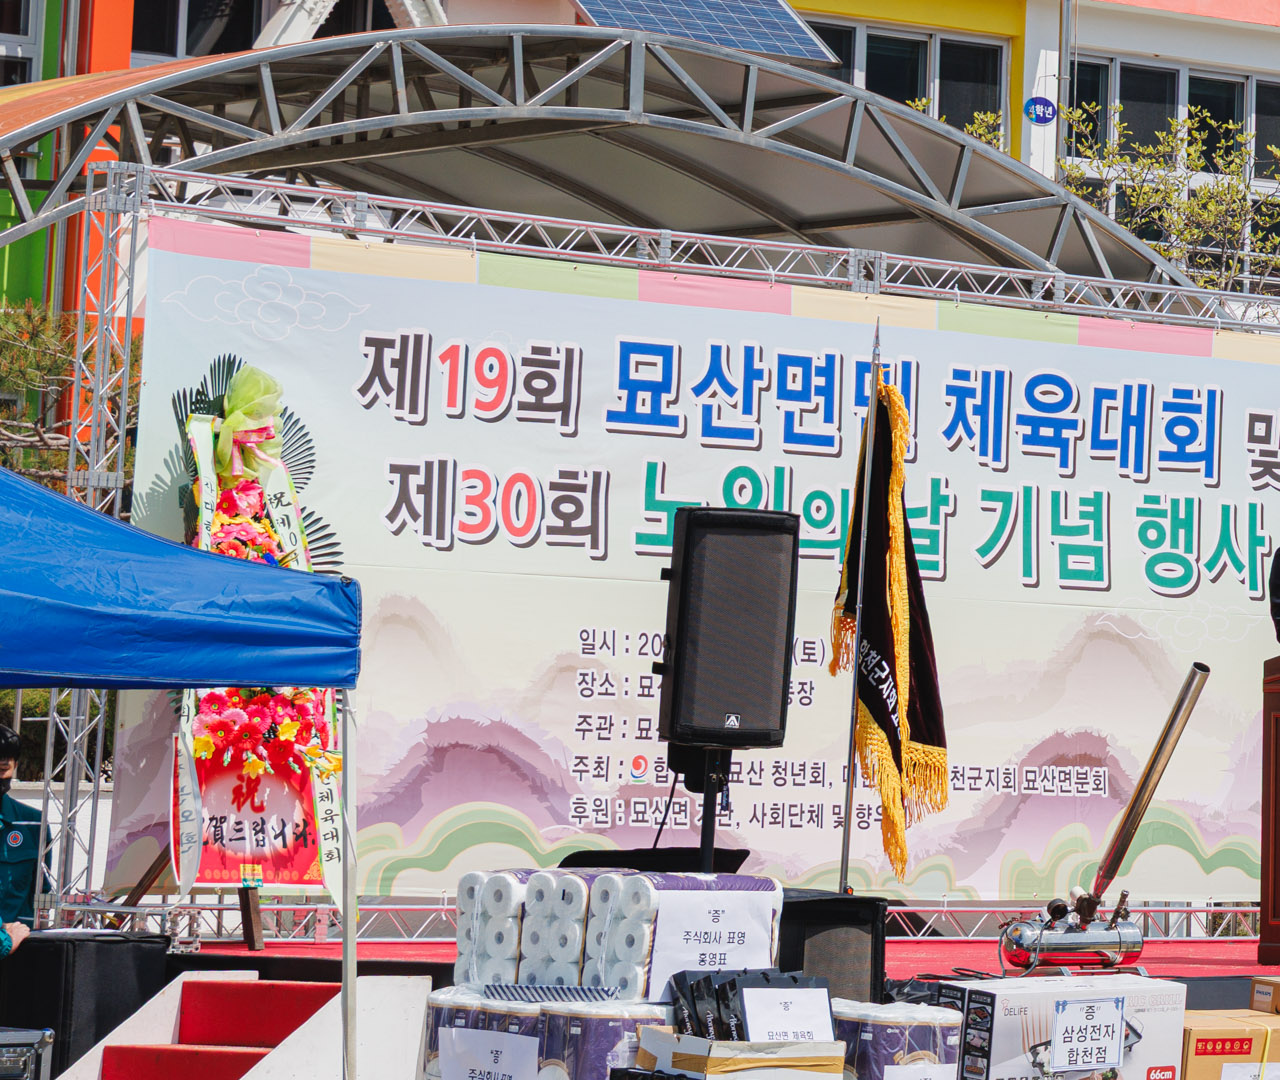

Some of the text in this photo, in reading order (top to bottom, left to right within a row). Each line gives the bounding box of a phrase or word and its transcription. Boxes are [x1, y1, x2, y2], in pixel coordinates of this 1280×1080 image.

[358, 331, 576, 434] 제19회
[943, 366, 1220, 480] 체육대회
[386, 461, 604, 555] 제30회
[977, 485, 1104, 583] 기념
[1136, 494, 1267, 595] 행사
[579, 629, 616, 656] 일시
[577, 672, 616, 698] 장소
[575, 714, 613, 741] 주관
[572, 755, 610, 782] 주최
[771, 760, 833, 789] 청년회,
[950, 766, 1017, 792] 천군지회
[1022, 769, 1108, 796] 묘산면분회
[231, 774, 265, 813] 祝
[571, 797, 608, 825] 후원
[631, 800, 688, 826] 묘산면
[749, 802, 824, 829] 사회단체
[682, 931, 746, 945] 주식회사 표영
[698, 952, 727, 966] 홍영표
[1256, 989, 1272, 997] PHILIPS
[1004, 1007, 1028, 1016] DELIFE
[767, 1031, 814, 1041] 묘산면 체육회
[1062, 1023, 1116, 1043] 삼성전자
[1067, 1046, 1107, 1065] 합천점
[1149, 1069, 1173, 1080] 66cm
